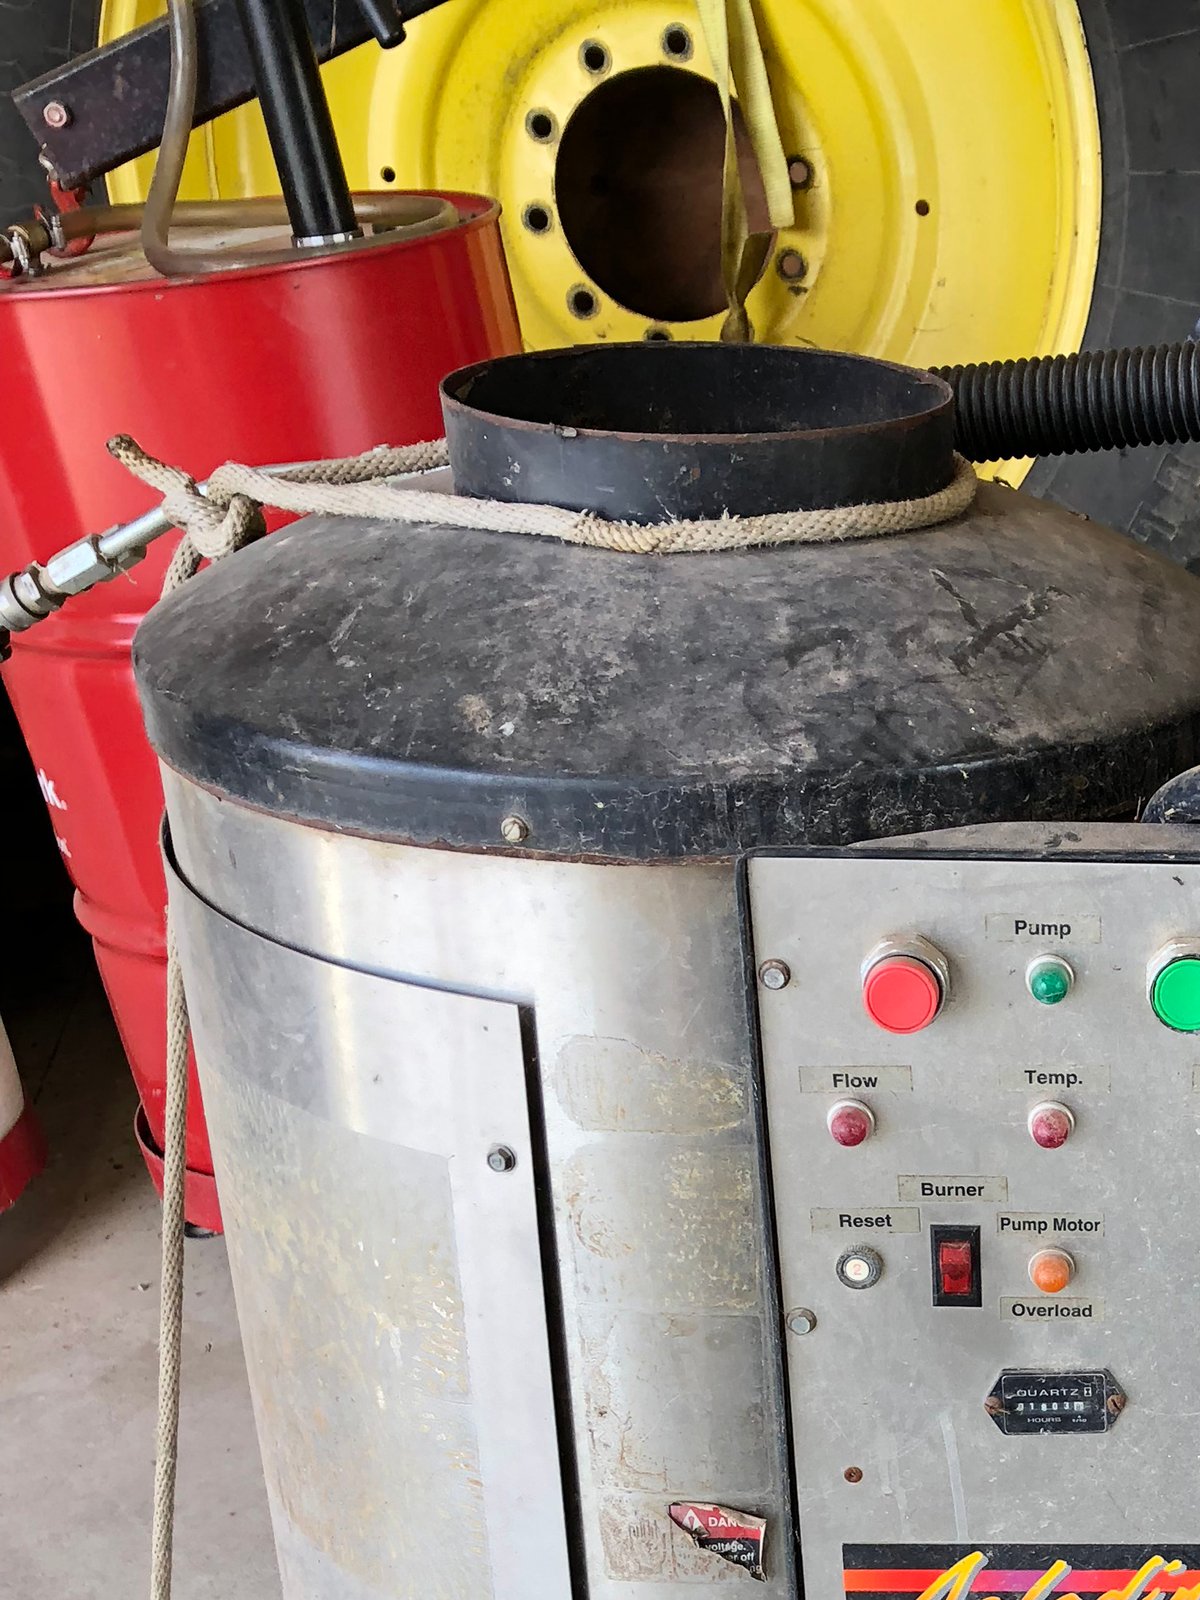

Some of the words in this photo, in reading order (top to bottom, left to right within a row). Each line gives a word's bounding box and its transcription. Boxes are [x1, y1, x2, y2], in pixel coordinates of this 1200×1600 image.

[1014, 919, 1071, 938] Pump
[832, 1074, 878, 1088] Flow
[1024, 1070, 1083, 1088] Temp.
[921, 1182, 984, 1197] Burner
[839, 1214, 892, 1227] Reset
[1000, 1217, 1048, 1233] Pump
[1053, 1217, 1101, 1232] Motor
[1011, 1303, 1093, 1318] Overload
[1016, 1388, 1079, 1397] QUARTZ
[740, 1552, 755, 1561] off
